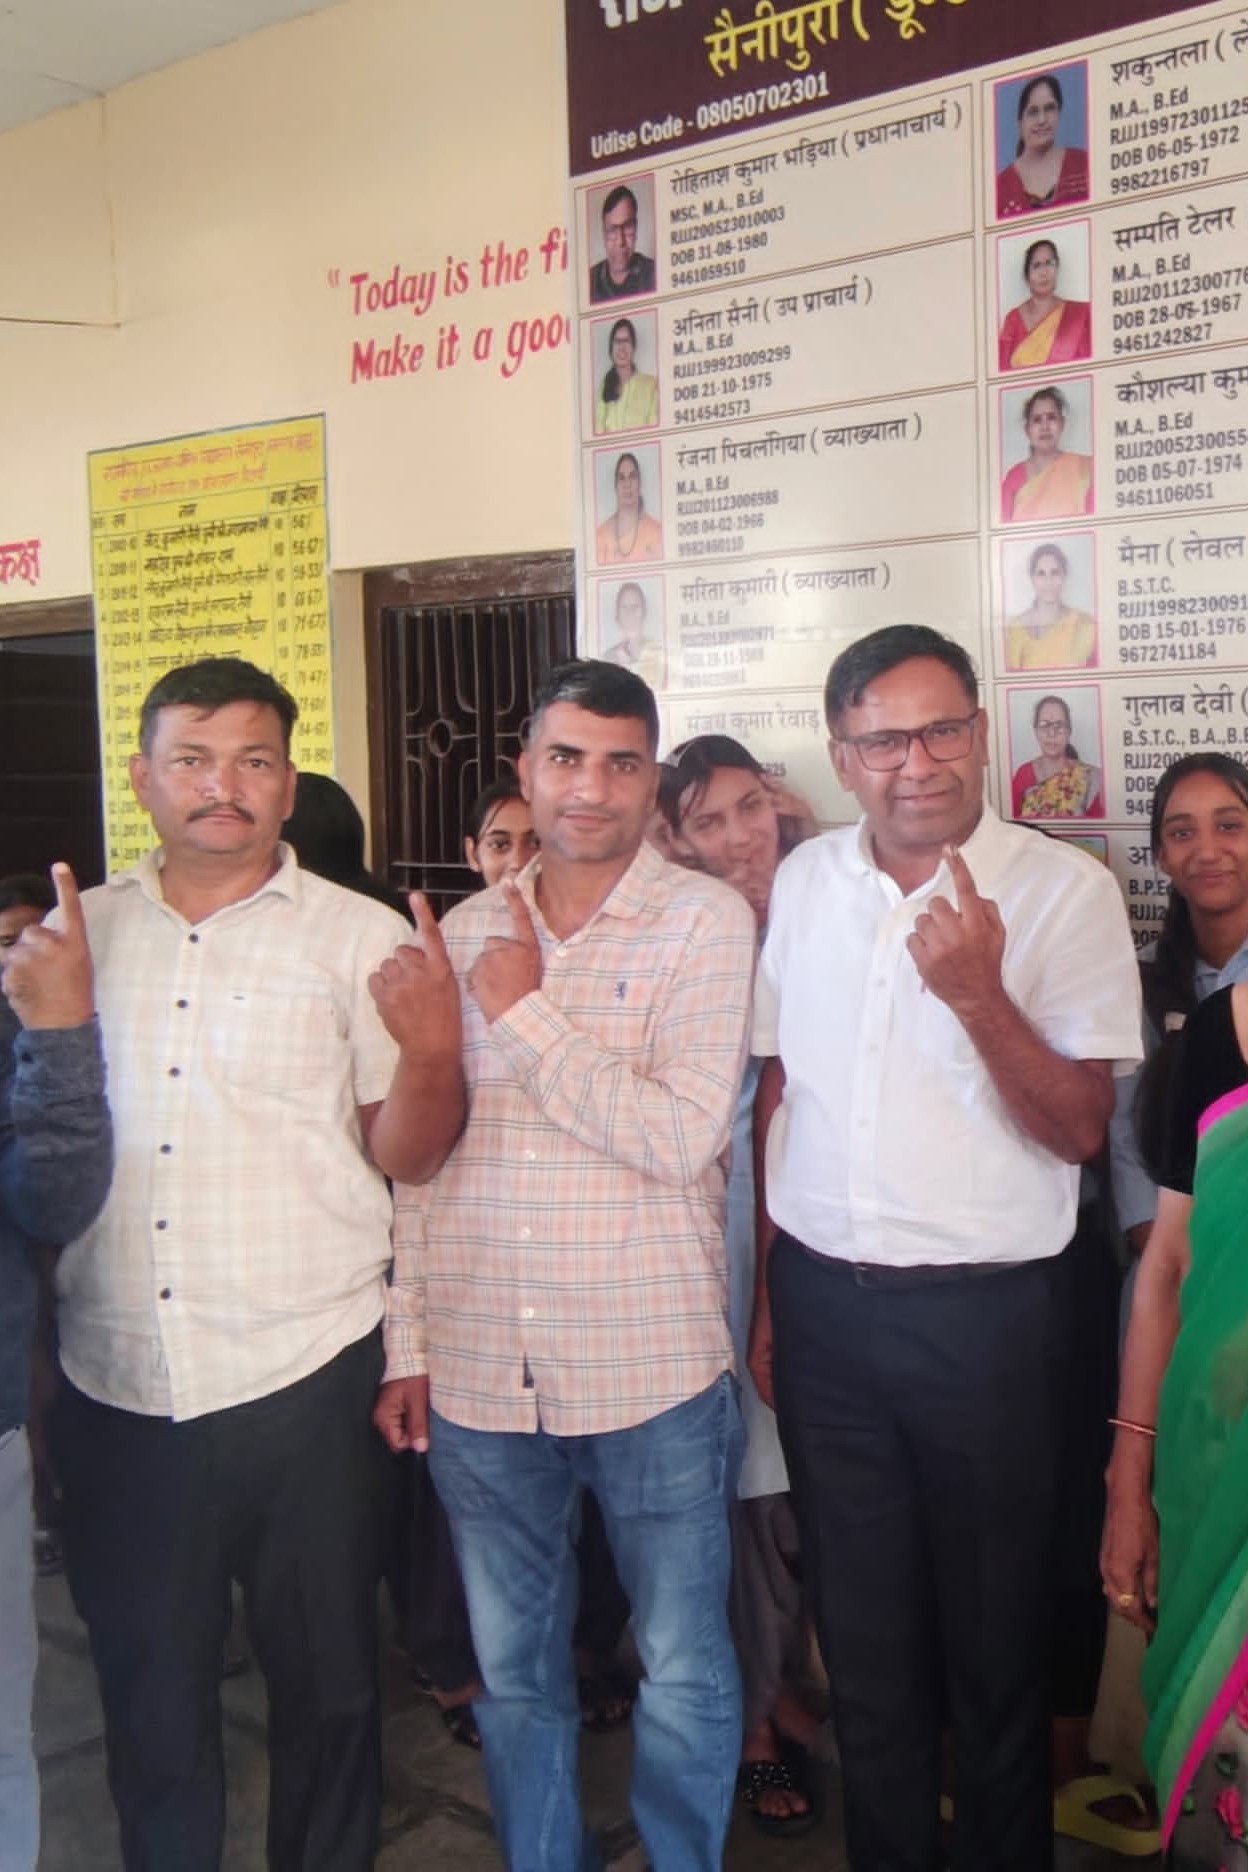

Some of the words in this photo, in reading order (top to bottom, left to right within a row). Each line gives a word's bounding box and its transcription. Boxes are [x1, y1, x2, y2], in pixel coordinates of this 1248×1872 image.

[704, 0, 844, 76] सैनीपुरा
[1110, 39, 1210, 86] शकुन्तला
[591, 127, 637, 159] Udise
[640, 118, 684, 146] Code
[697, 71, 829, 129] 08050702301
[1154, 86, 1189, 111] B.Ed
[1111, 148, 1143, 171] DOB
[1146, 126, 1240, 161] 06-05-1972
[734, 152, 778, 186] कुमार
[1111, 158, 1210, 195] 9982216797
[736, 188, 764, 208] B.Ed
[1186, 205, 1236, 236] टेलर
[671, 248, 695, 267] DOB
[1155, 253, 1191, 276] B.Ed
[350, 264, 437, 316] Today
[443, 255, 469, 297] is
[480, 240, 529, 289] the
[673, 309, 721, 338] अनिता
[727, 297, 758, 327] सैनी
[1113, 311, 1145, 331] DOB
[350, 333, 425, 385] Make
[437, 323, 460, 370] it
[473, 327, 494, 362] a
[706, 333, 733, 351] B.Ed
[1113, 322, 1213, 355] 9461242827
[673, 384, 698, 402] DOB
[1115, 370, 1206, 403] कौशल्या
[1158, 412, 1193, 432] B.Ed
[1116, 466, 1147, 485] DOB
[1151, 454, 1243, 481] 05-07-1974
[1118, 536, 1161, 567] मैना
[1182, 530, 1246, 562] लेवल
[1119, 624, 1150, 641] DOB
[1156, 617, 1246, 640] 15-01-1976
[1122, 693, 1185, 726] गुलाब
[1191, 684, 1235, 719] देवी
